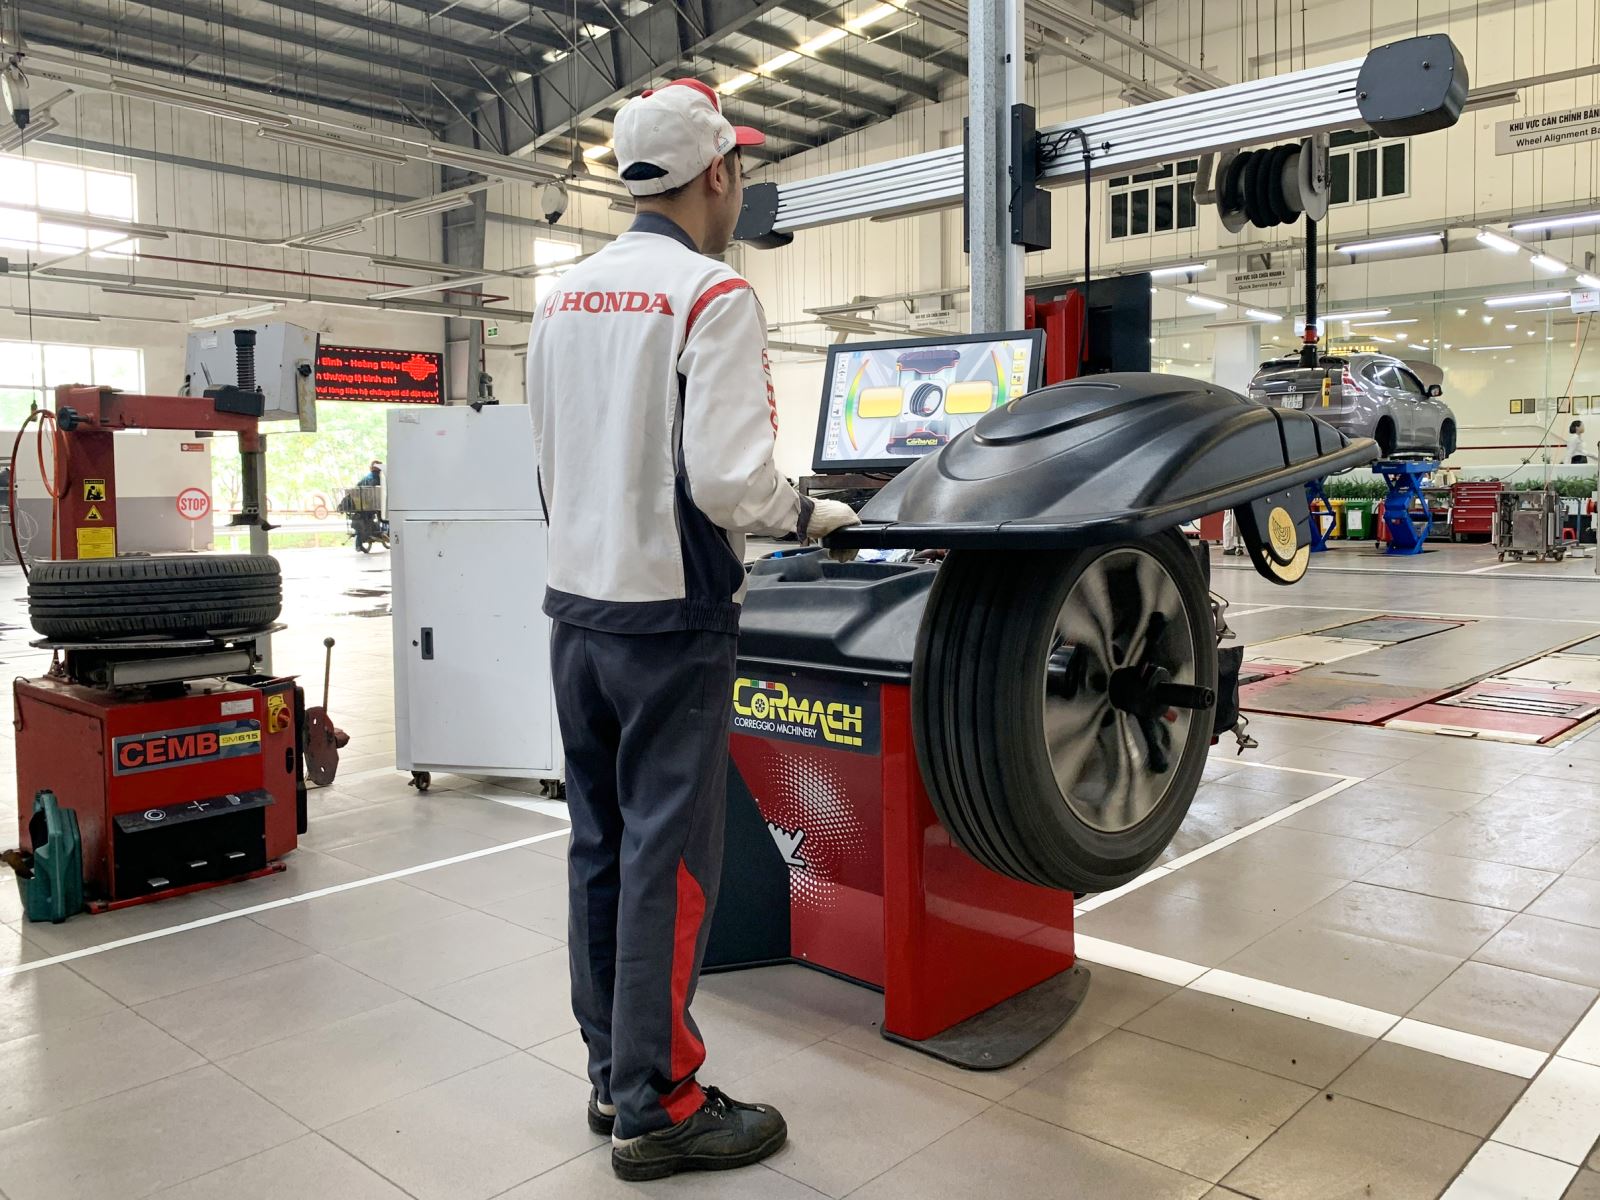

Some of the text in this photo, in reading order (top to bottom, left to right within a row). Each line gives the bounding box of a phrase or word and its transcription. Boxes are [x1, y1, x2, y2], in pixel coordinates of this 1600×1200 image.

[1510, 122, 1524, 132] KHU
[1516, 136, 1542, 147] Wheel
[1544, 129, 1588, 142] Alignment
[559, 292, 674, 316] HONDA
[181, 498, 206, 511] STOP
[733, 678, 862, 746] CORMACH
[734, 717, 818, 738] CORREGGIO MACHINERY
[120, 732, 258, 767] CEMB SM615
